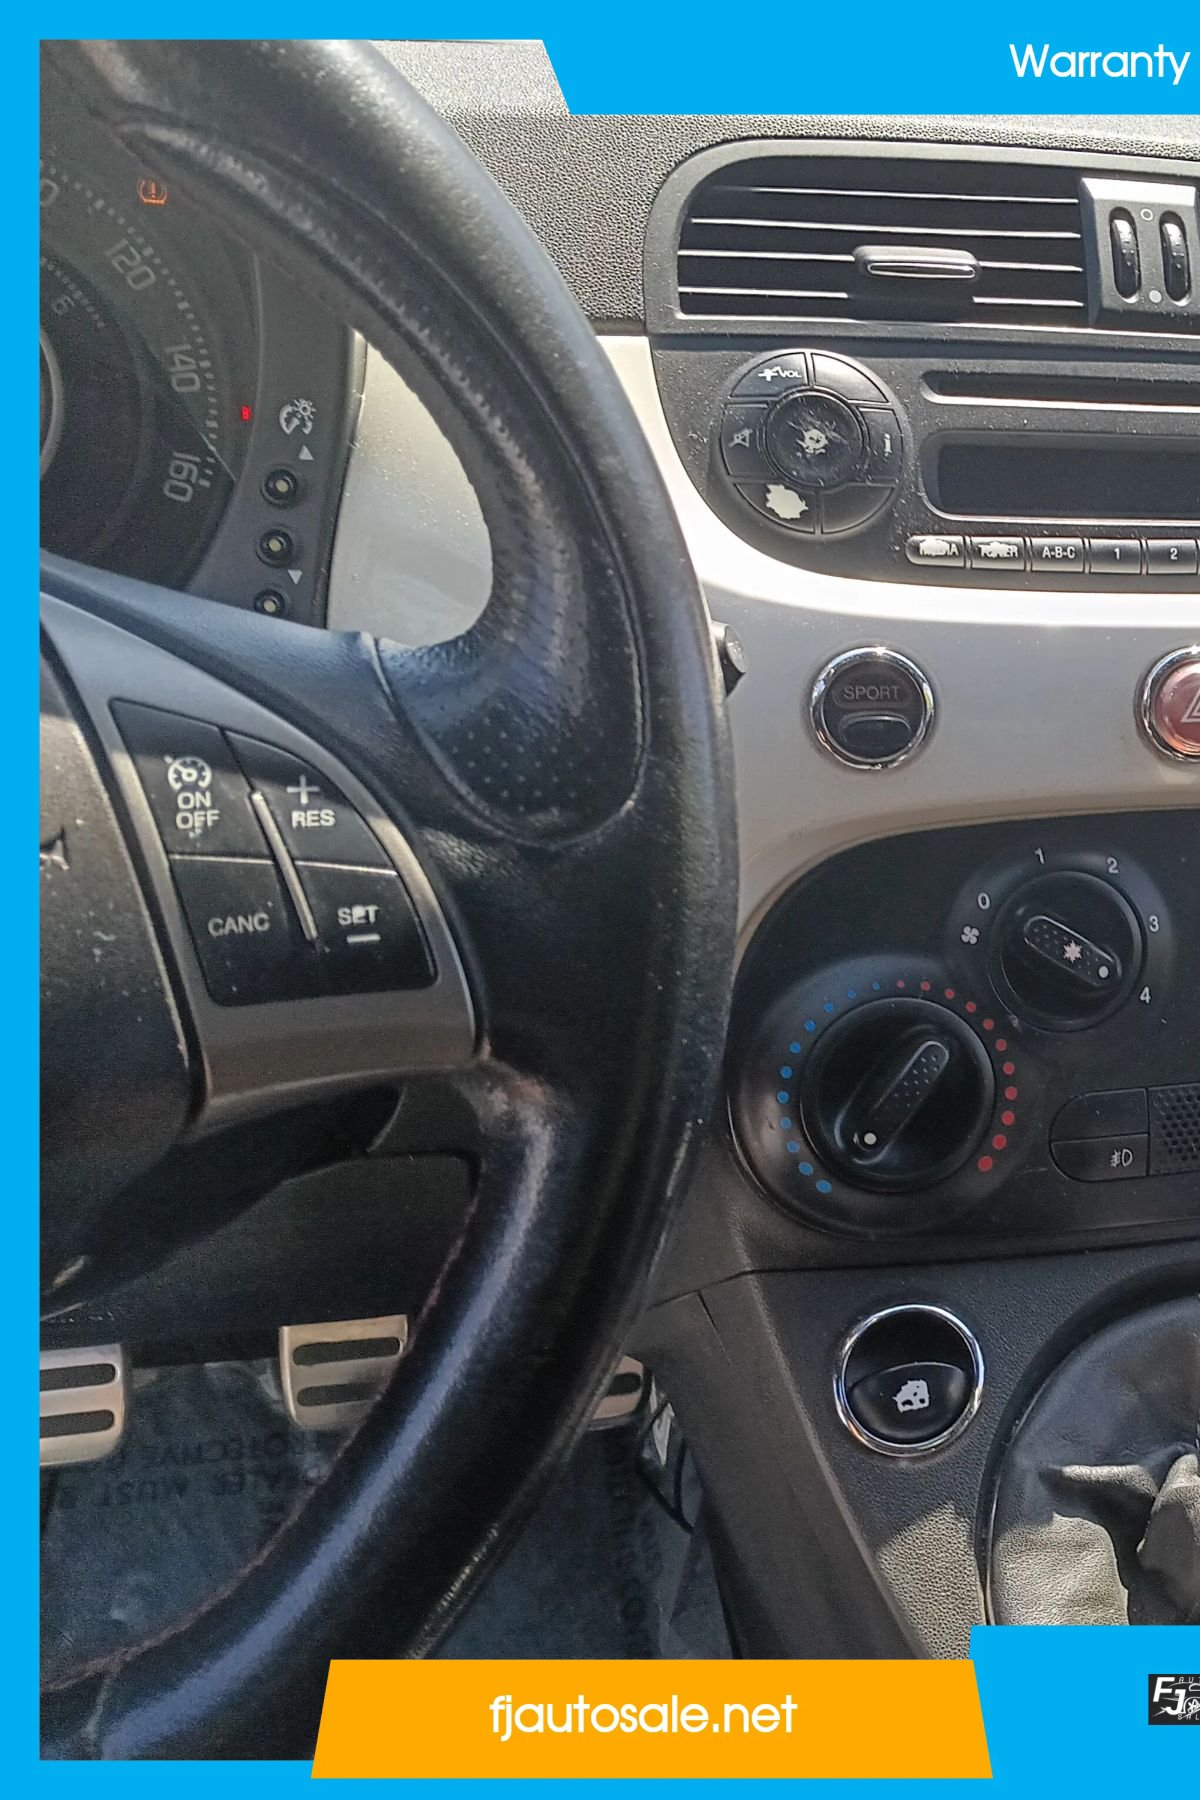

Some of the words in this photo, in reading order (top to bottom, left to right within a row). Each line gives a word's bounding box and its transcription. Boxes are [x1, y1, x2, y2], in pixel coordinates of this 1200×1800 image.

[105, 238, 156, 291] 120
[164, 344, 200, 393] 140
[163, 451, 200, 502] 160
[1041, 546, 1076, 559] A-B-C
[1113, 547, 1121, 560] 1
[1169, 547, 1179, 560] 2
[843, 685, 901, 700] SPORT
[177, 792, 212, 809] ON
[176, 809, 220, 830] OFF
[291, 809, 336, 828] RES
[1034, 848, 1045, 864] 1
[1107, 856, 1119, 874] 2
[977, 892, 990, 910] 0
[208, 912, 271, 937] CANC
[1149, 915, 1159, 932] 3
[1139, 985, 1151, 1004] 4
